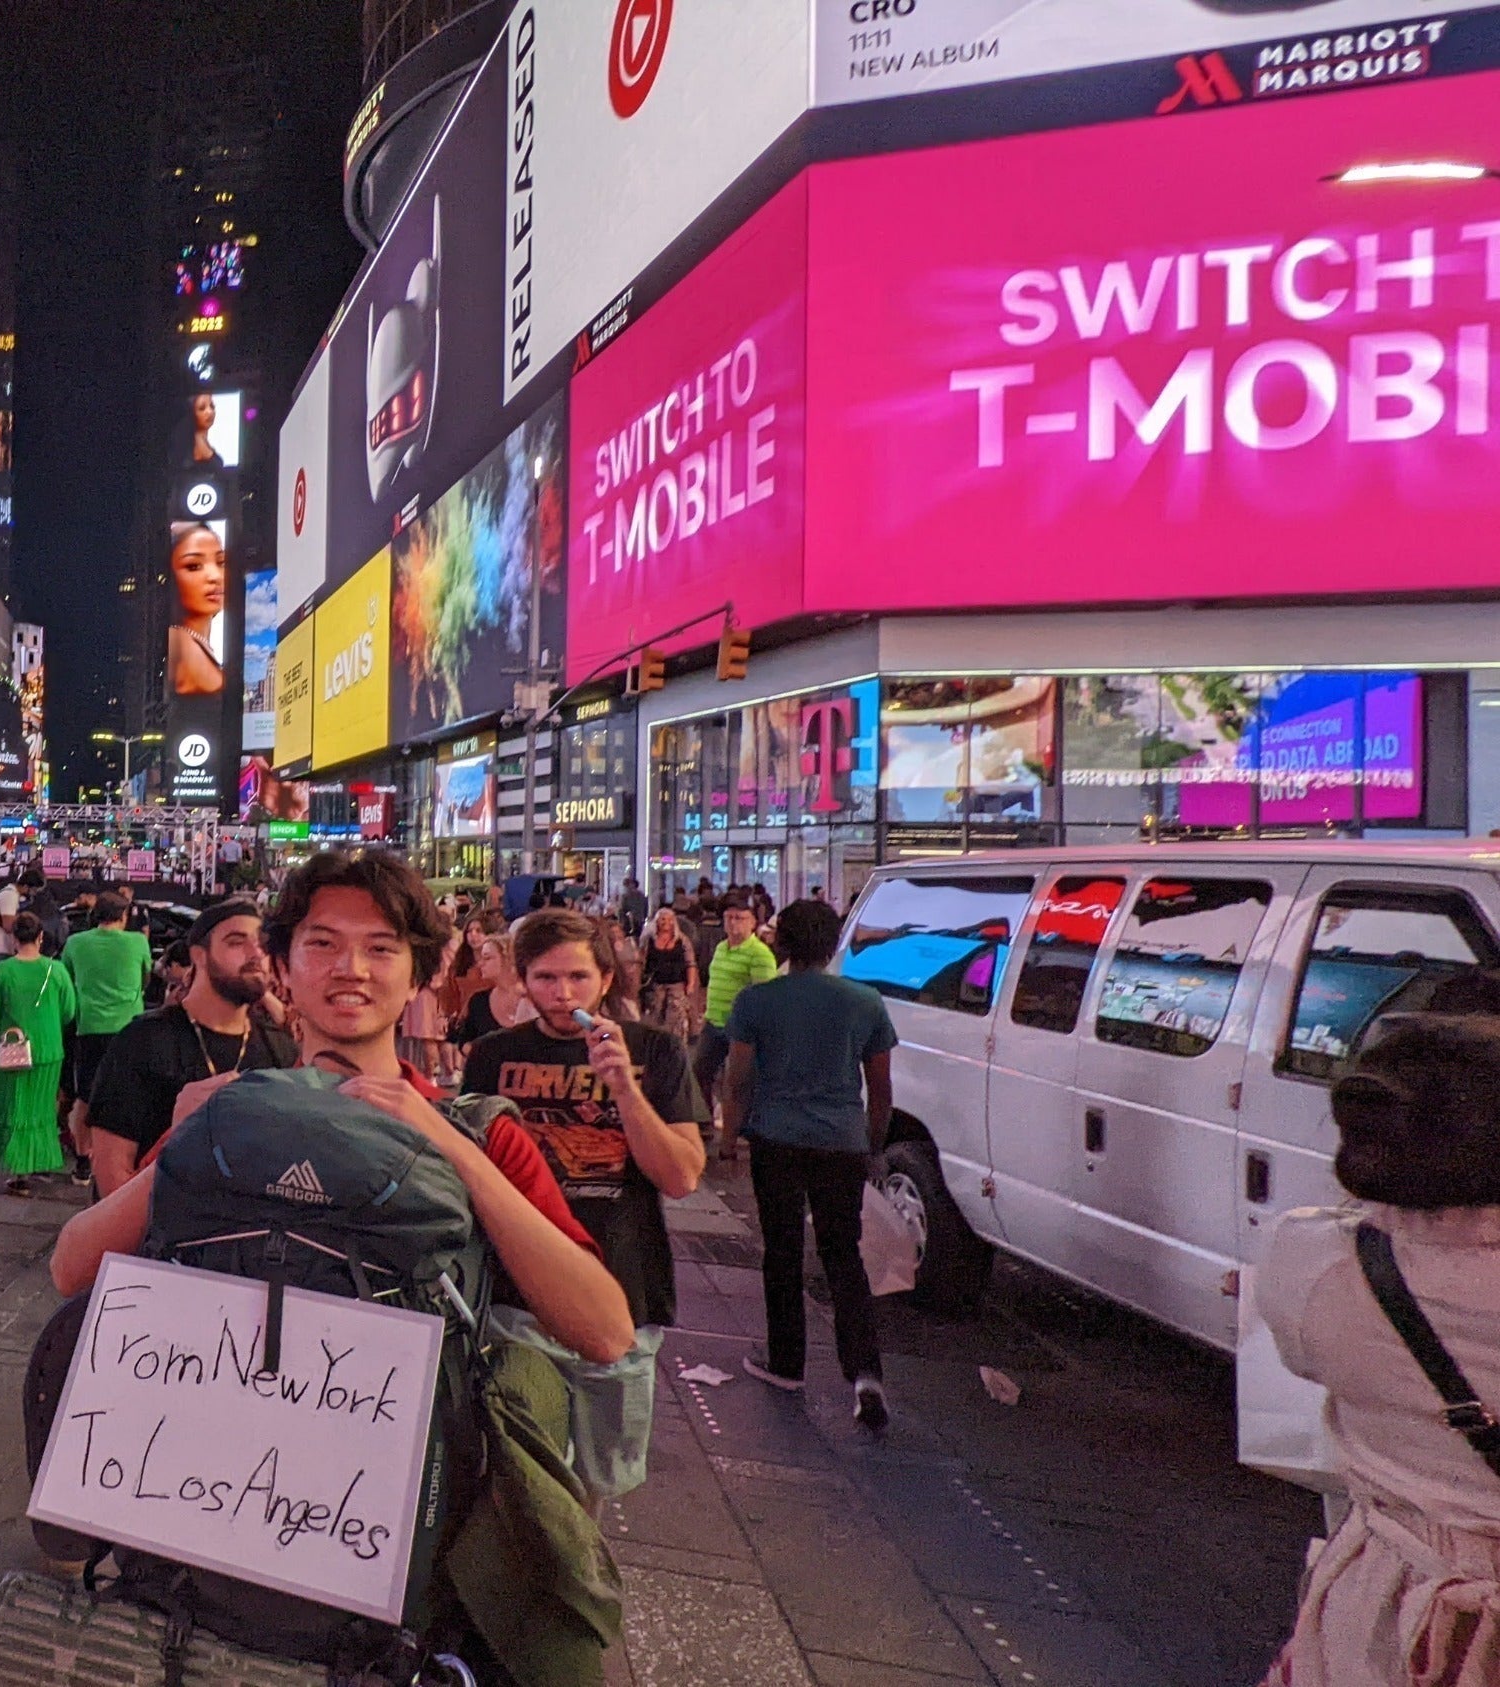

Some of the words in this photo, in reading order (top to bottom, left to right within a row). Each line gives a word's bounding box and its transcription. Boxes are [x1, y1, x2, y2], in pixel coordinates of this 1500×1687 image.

[848, 28, 892, 53] 11:11
[1258, 19, 1448, 69] MARRIOTT
[849, 53, 905, 81] NEW
[910, 37, 1000, 71] ALBUM
[1258, 49, 1422, 93] MARQUIS
[511, 7, 535, 383] RELEASED
[999, 226, 1435, 347] SWITCH
[1461, 217, 1500, 302] T
[190, 315, 224, 333] 2022
[949, 321, 1490, 469] T-MOBI
[594, 371, 705, 499] SWITCH
[709, 337, 758, 422] TO
[192, 492, 213, 507] JD
[583, 402, 777, 587] T-MOBILE
[576, 699, 611, 721] SEPHORA
[1269, 718, 1343, 744] CONNECTION
[184, 743, 206, 758] JD
[1277, 744, 1318, 772] DATA
[173, 775, 214, 784] BROADWAY
[555, 797, 615, 823] SEPHORA
[266, 1183, 333, 1206] GREGORY
[92, 1283, 204, 1385] From
[210, 1312, 311, 1402] New
[314, 1336, 399, 1425] York
[71, 1408, 125, 1490] To
[134, 1415, 232, 1512] Los
[232, 1446, 392, 1562] Angeles
